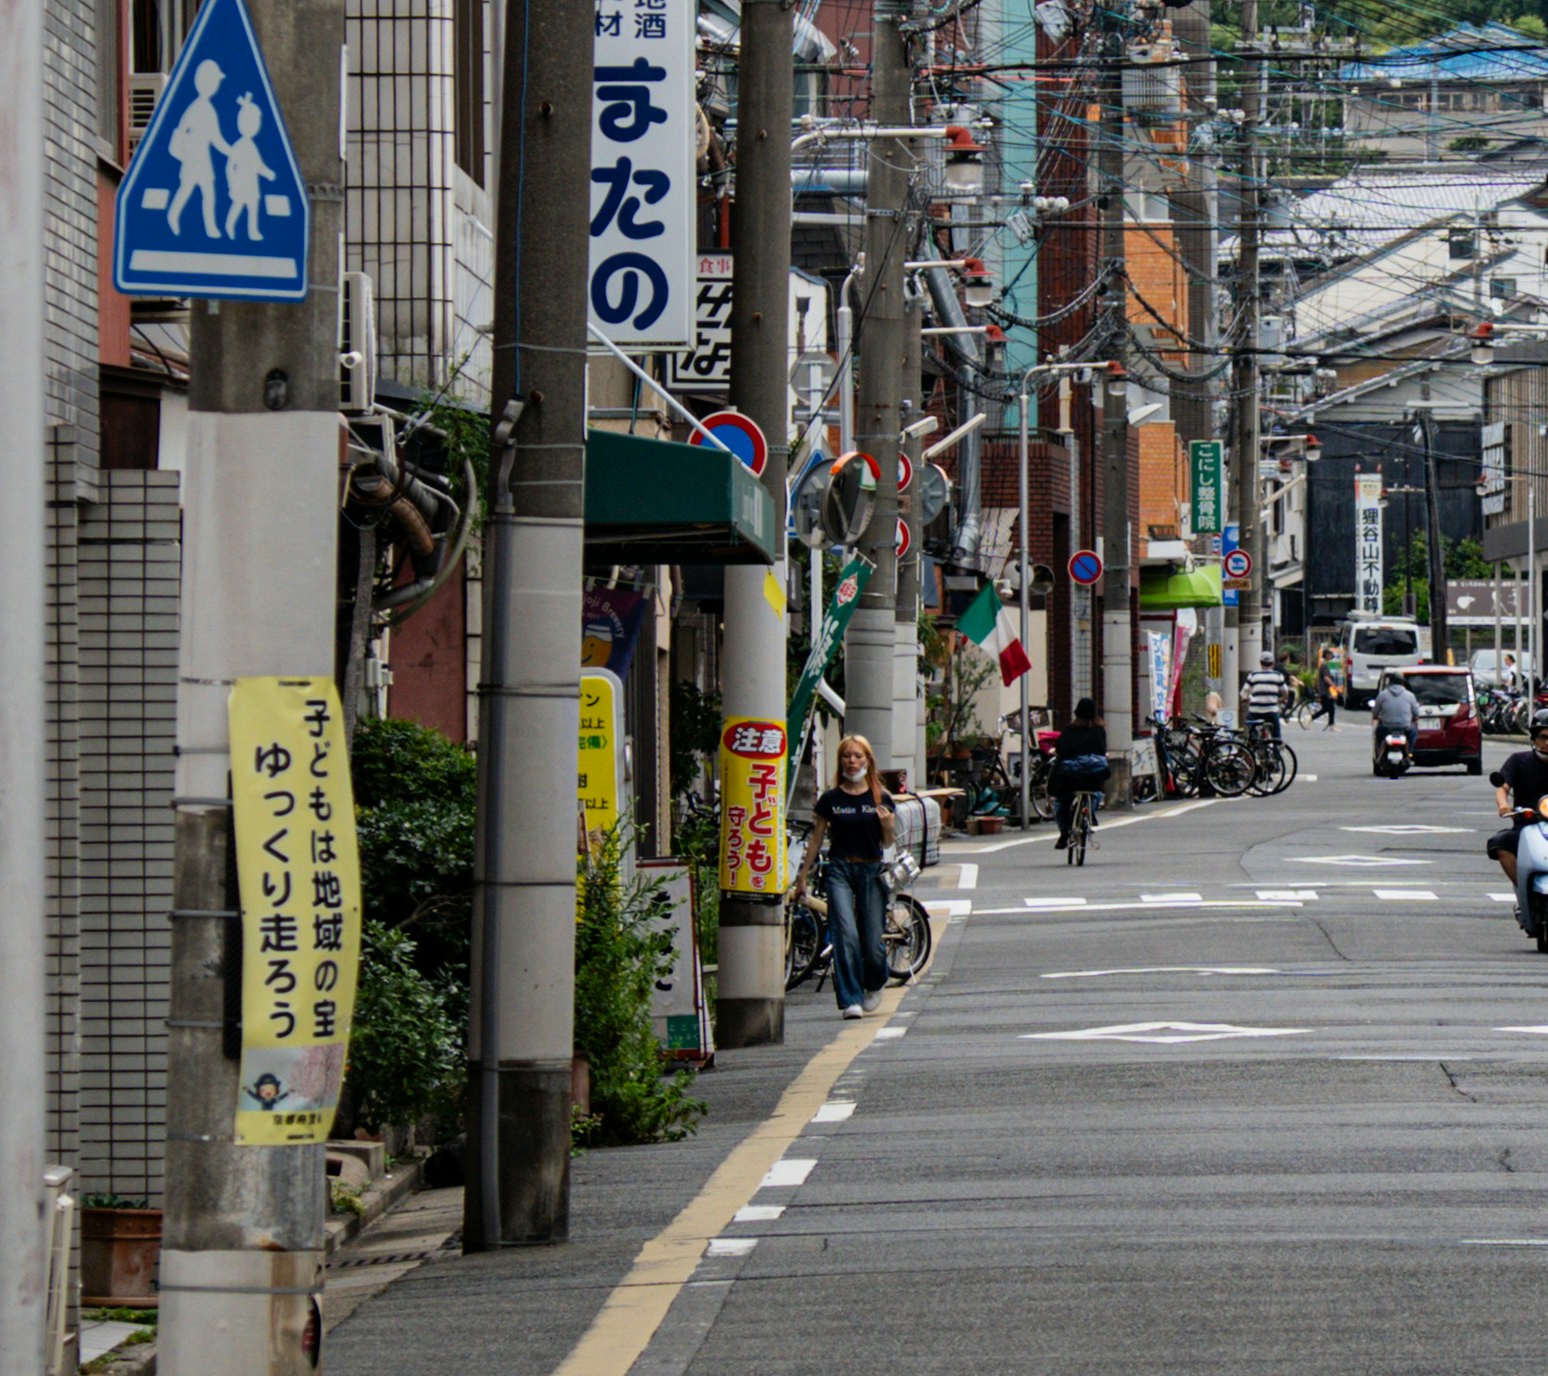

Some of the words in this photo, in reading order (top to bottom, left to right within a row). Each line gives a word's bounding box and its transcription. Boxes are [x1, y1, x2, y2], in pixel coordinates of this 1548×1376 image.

[699, 257, 731, 274] 食事
[1197, 444, 1216, 530] こにし整骨院
[732, 727, 783, 754] 注意
[303, 699, 344, 1038] 子どもは地域の宝
[745, 764, 778, 889] 子どもを
[254, 741, 299, 1039] ゆっくり走ろう
